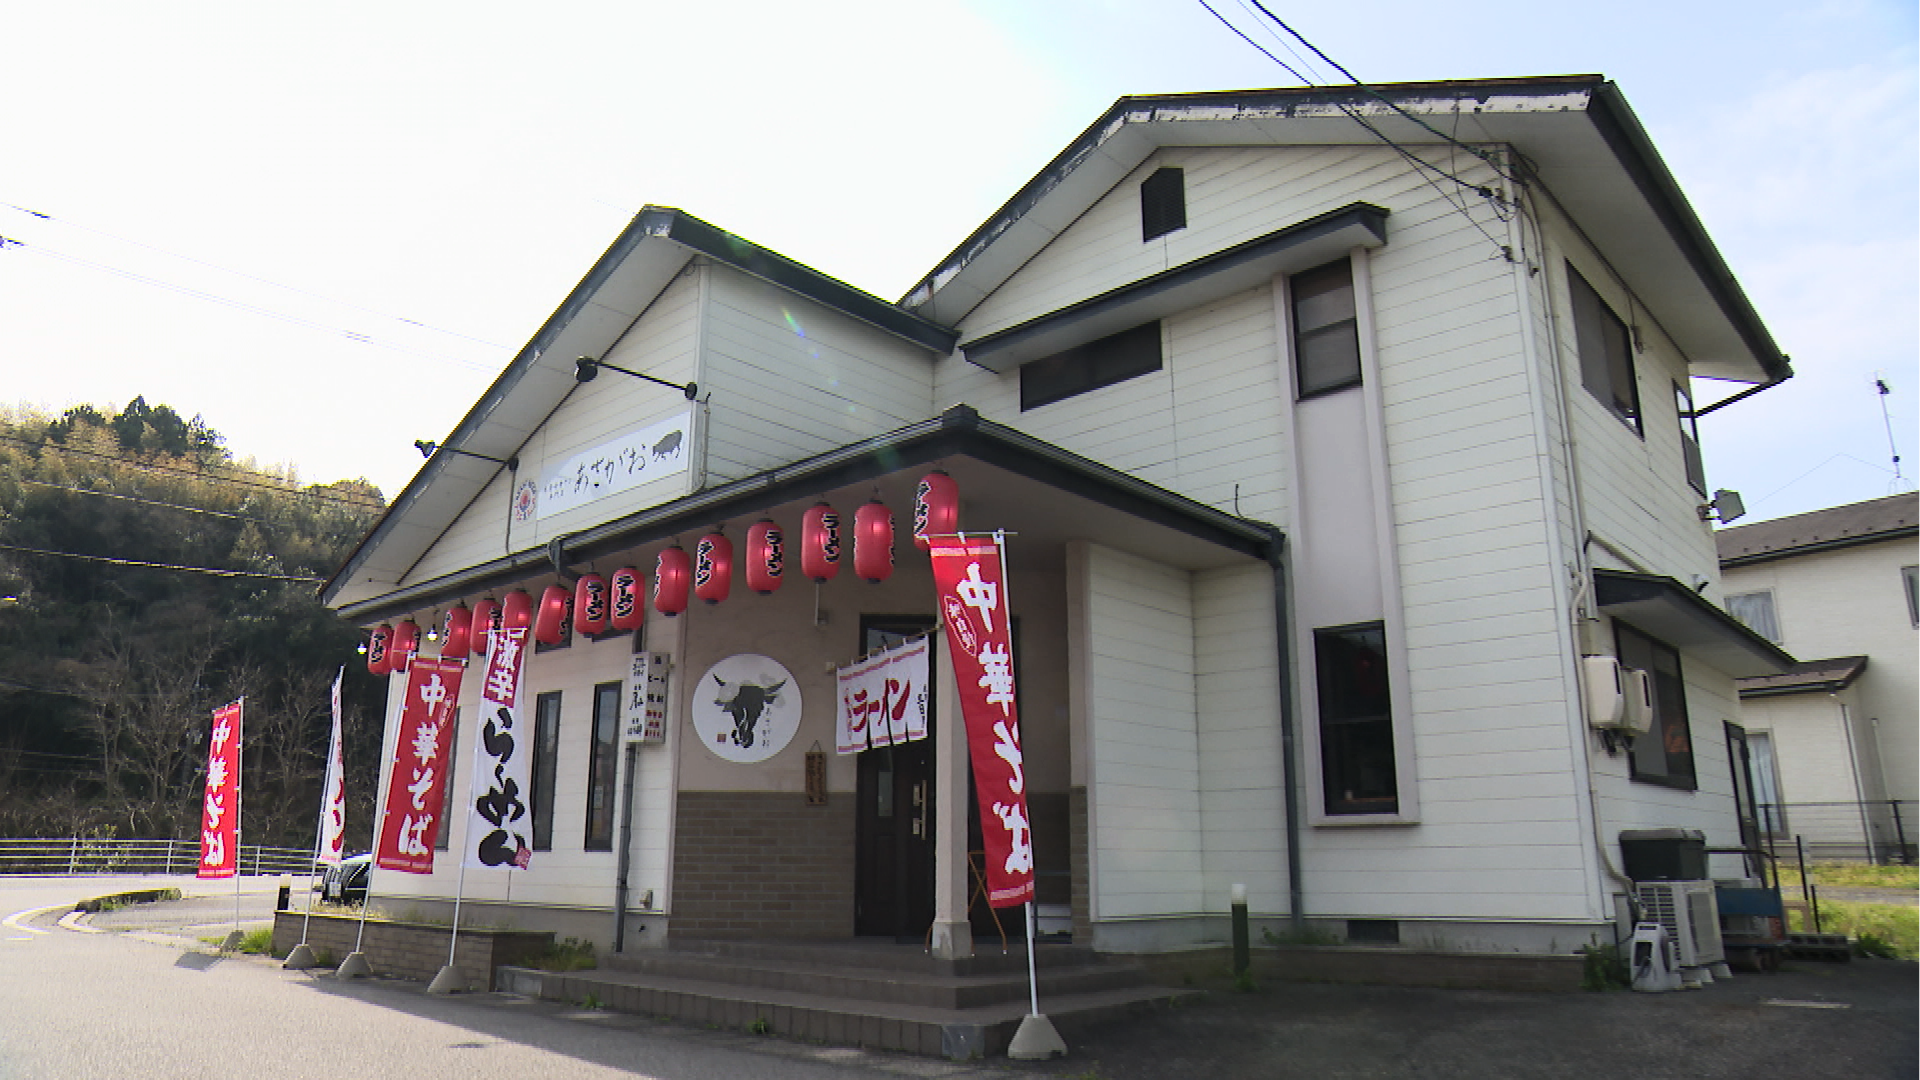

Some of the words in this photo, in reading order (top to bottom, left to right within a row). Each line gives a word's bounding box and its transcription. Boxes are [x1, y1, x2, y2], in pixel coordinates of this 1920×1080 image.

[574, 444, 647, 495] あさがお
[914, 480, 931, 536] ラーメン
[696, 539, 714, 587] ラーメン
[765, 529, 783, 578] ラーメン
[822, 512, 841, 564] ラーメン
[586, 580, 605, 622] ラーメン
[614, 573, 635, 619] ラーメン
[398, 673, 447, 856] 中華そば
[476, 706, 526, 867] らーめん
